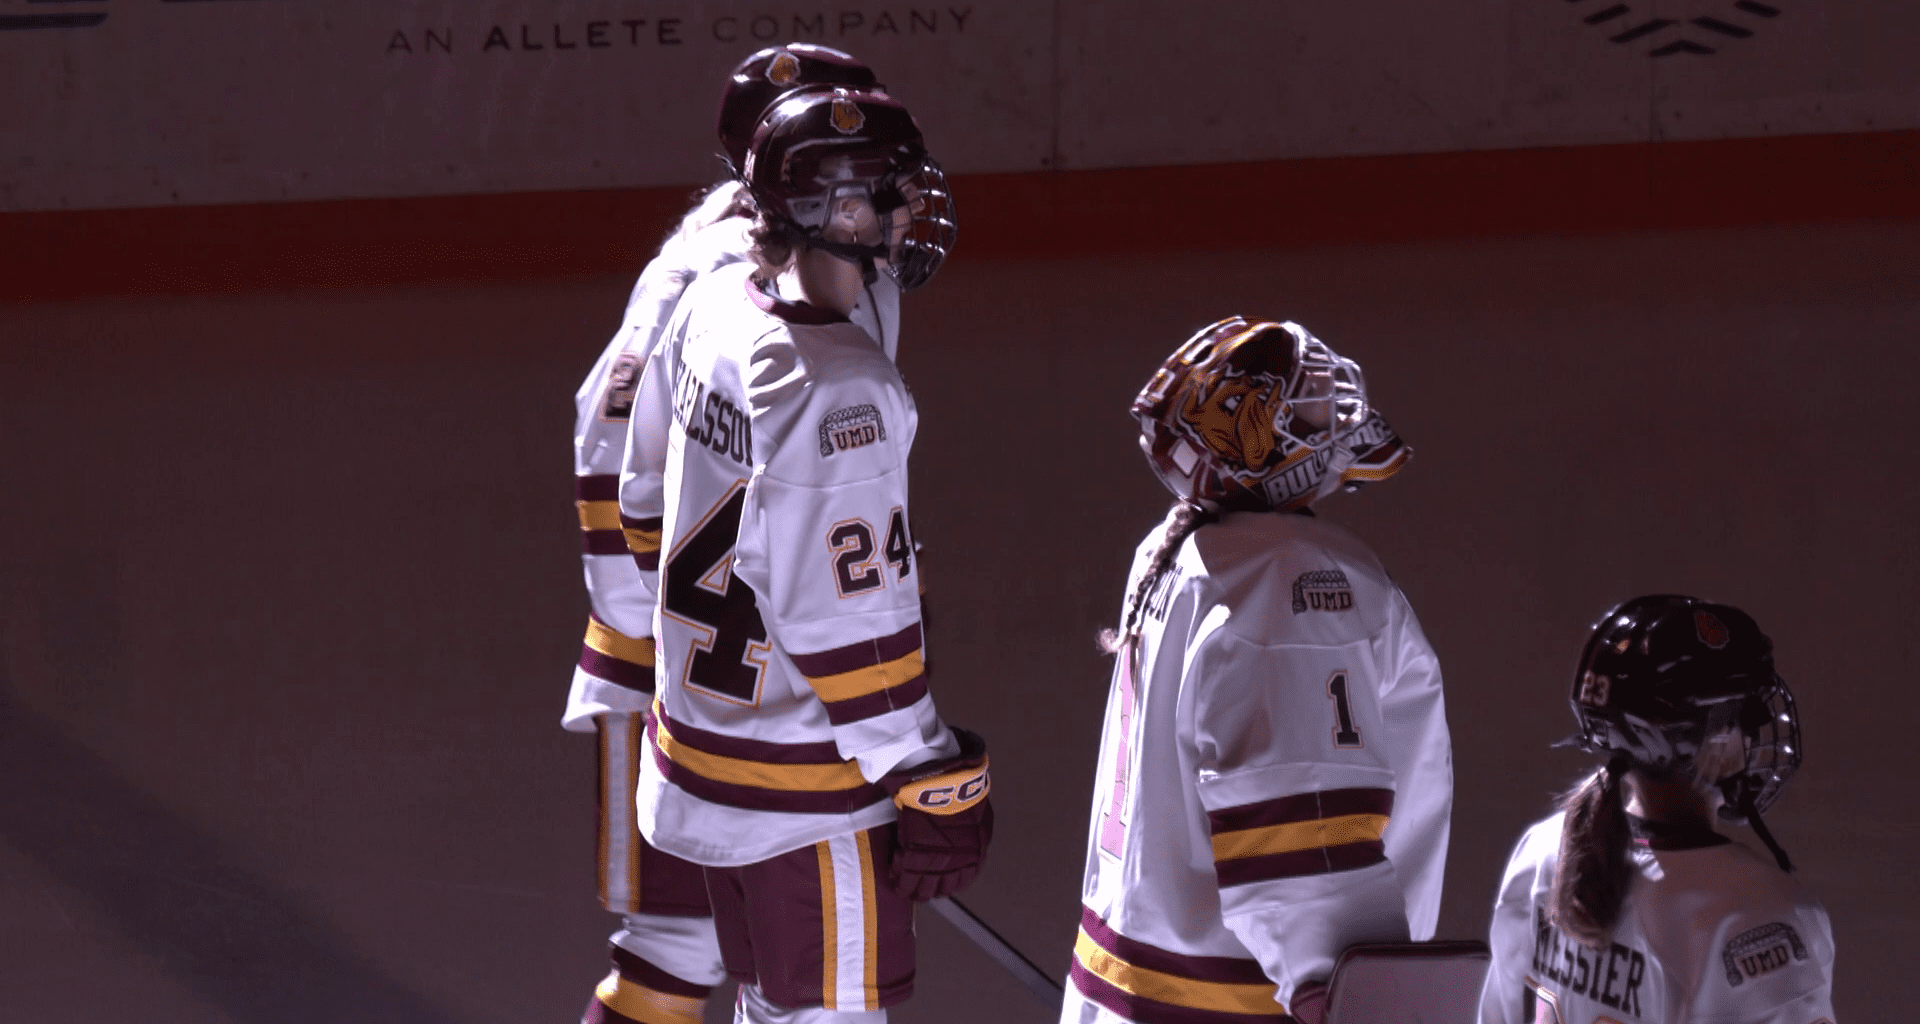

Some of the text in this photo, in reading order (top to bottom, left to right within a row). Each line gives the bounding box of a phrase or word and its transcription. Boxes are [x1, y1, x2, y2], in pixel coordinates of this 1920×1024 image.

[388, 7, 973, 53] AN ALLETE COMPANY
[834, 424, 876, 452] UMD
[826, 504, 912, 600] 24
[1307, 590, 1354, 612] UMD
[1580, 668, 1610, 706] 23
[1326, 668, 1364, 750] 1
[1532, 905, 1646, 1018] MESSIER
[1741, 946, 1789, 977] UMD
